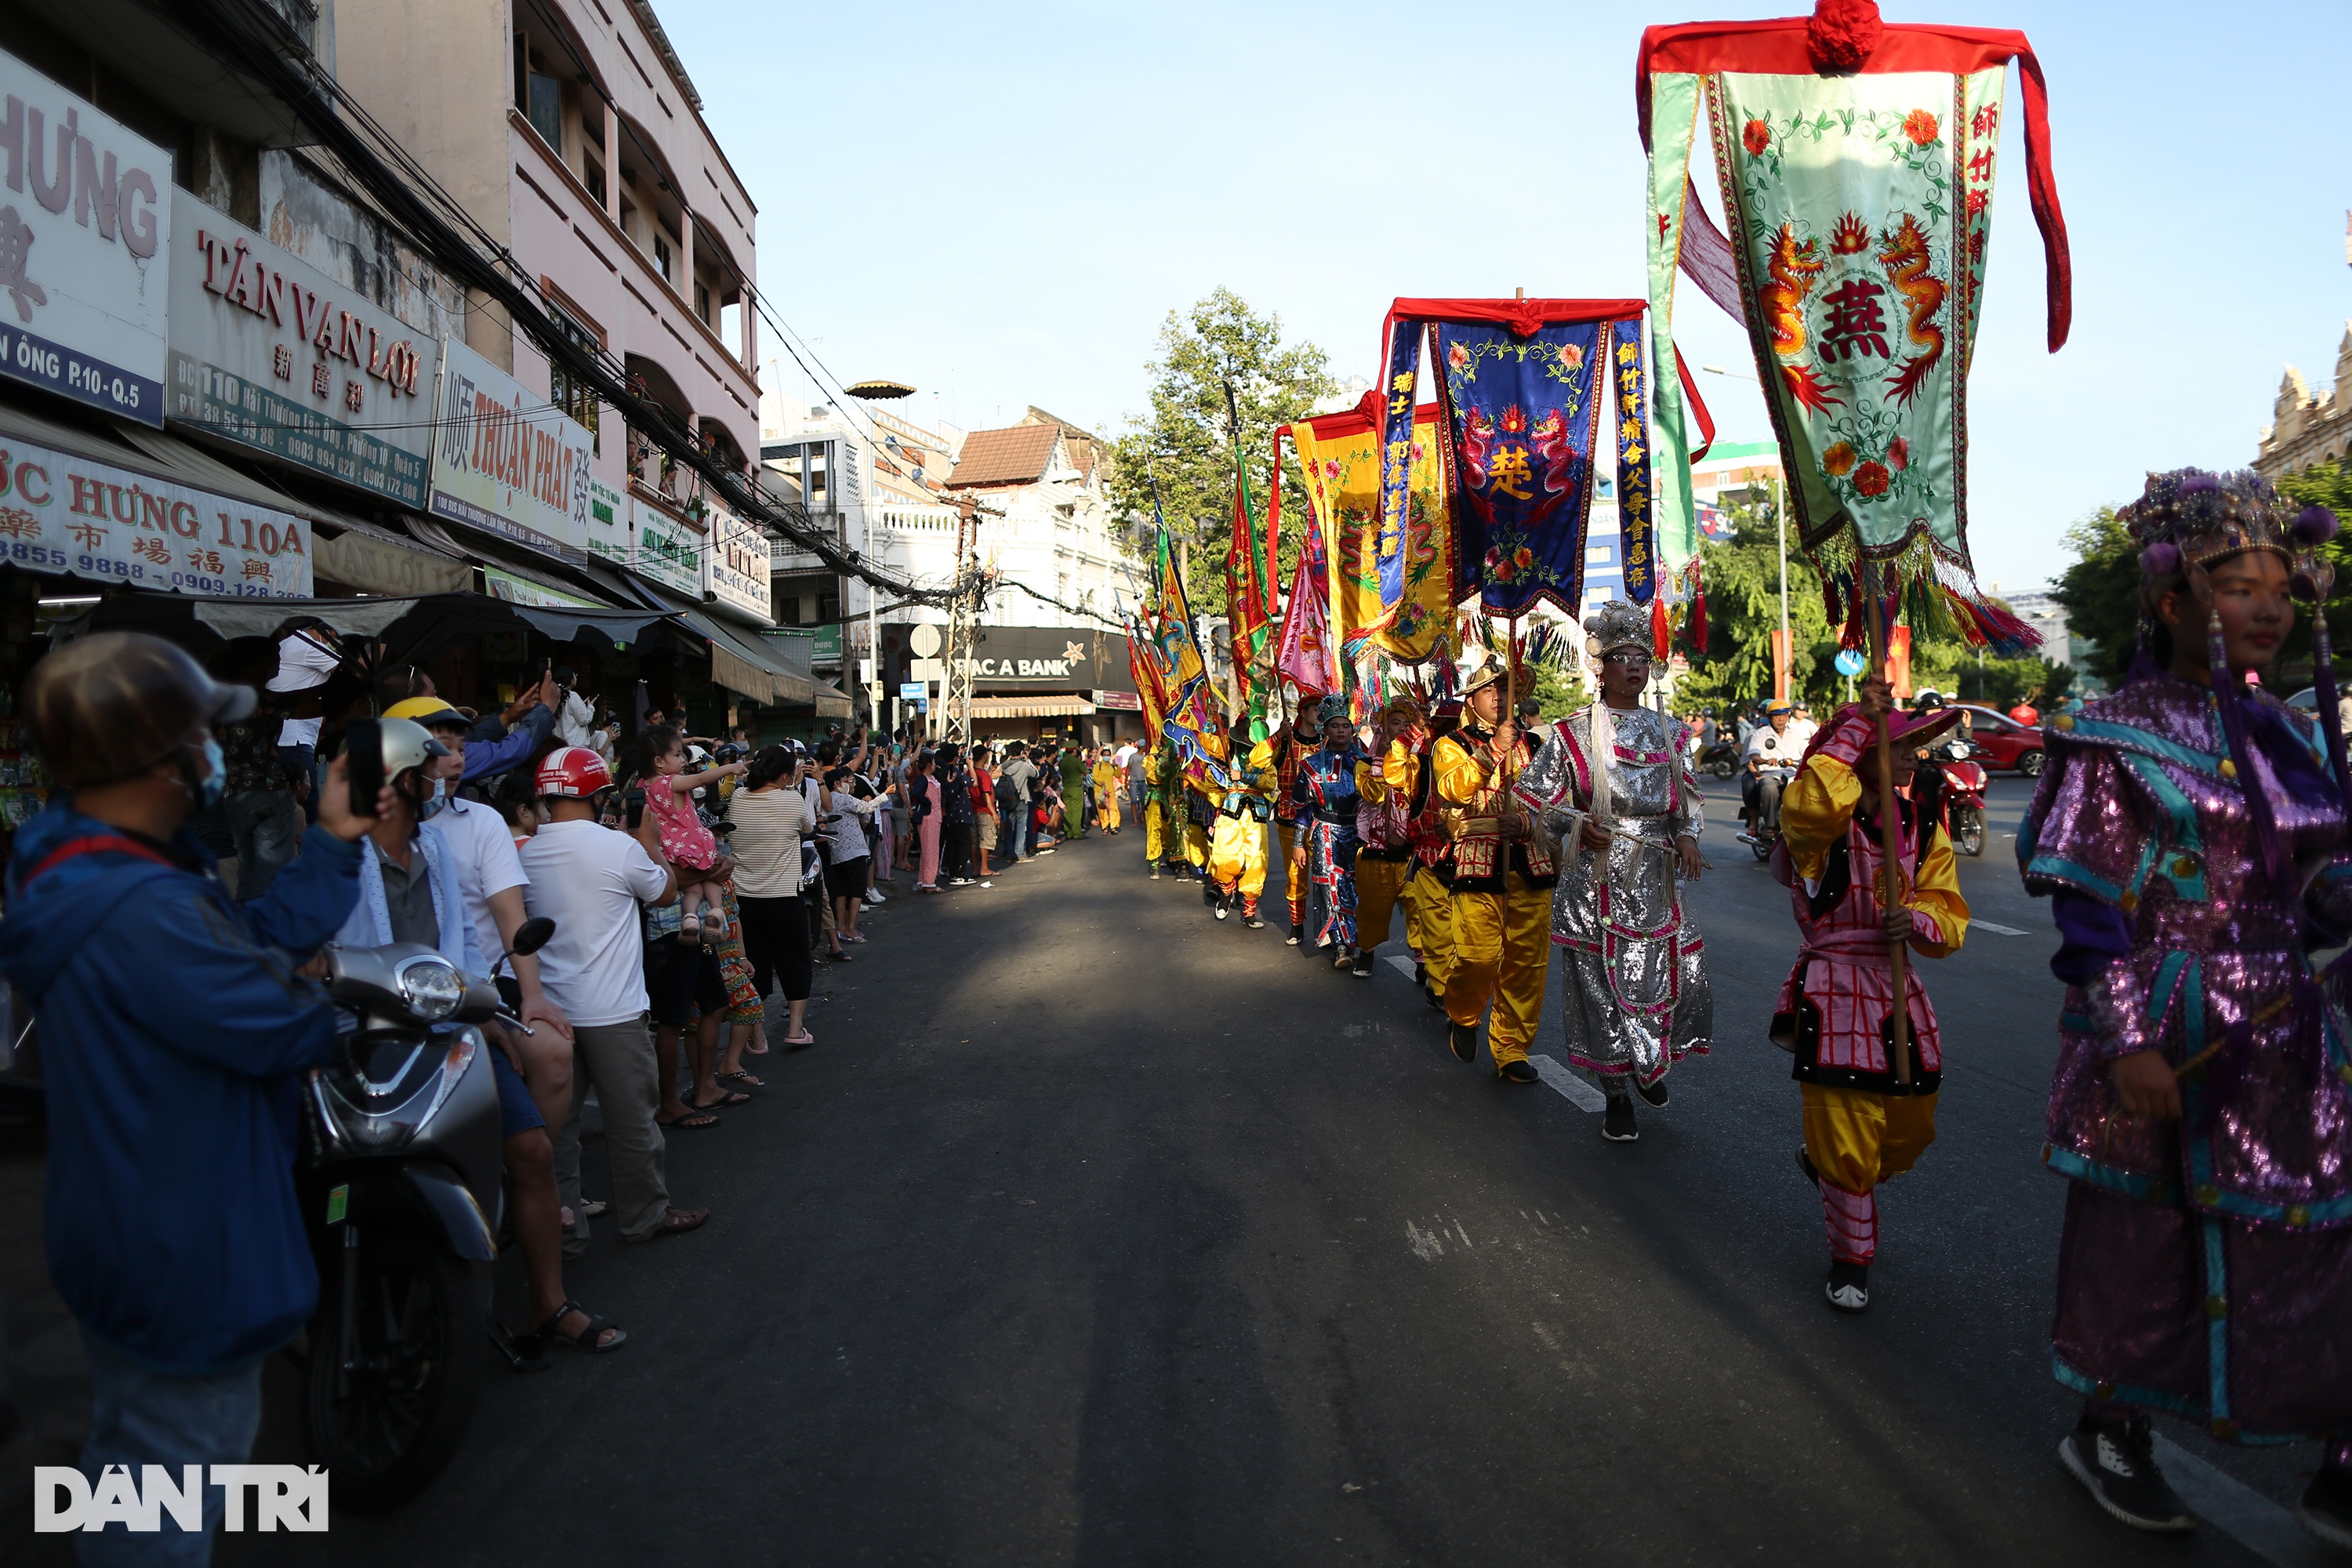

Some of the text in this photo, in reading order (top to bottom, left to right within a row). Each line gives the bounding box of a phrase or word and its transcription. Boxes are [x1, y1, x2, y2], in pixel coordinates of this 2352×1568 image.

[198, 230, 421, 398] TÂN VẠN LỢI
[1817, 278, 1891, 365] 燕
[16, 335, 60, 379] ÔNG
[68, 360, 101, 394] P.10
[111, 378, 140, 408] Q.5
[274, 343, 365, 413] 新萬利
[201, 366, 239, 407] 110
[243, 387, 260, 414] Hải
[303, 413, 320, 439] Lãn
[347, 432, 378, 465] Phường
[379, 446, 388, 467] 10
[394, 452, 416, 479] Quận
[414, 461, 420, 480] 5
[205, 402, 220, 425] 38
[223, 410, 238, 433] 55
[242, 418, 257, 441] 99
[260, 426, 274, 447] 86
[288, 437, 313, 462] 0903
[317, 448, 336, 470] 994
[338, 456, 355, 477] 628
[364, 466, 385, 489] 0903
[387, 477, 401, 495] 172
[402, 487, 418, 502] 808
[472, 390, 572, 514] THUẬN PHÁT
[1488, 445, 1534, 500] 楚
[1615, 342, 1650, 588] 師竹軒精舍父母會惠存
[67, 473, 200, 541] HƯNG
[217, 513, 304, 557] 110A
[437, 495, 448, 510] 108
[593, 497, 614, 526] NAM
[78, 555, 143, 579] 9888
[814, 641, 833, 650] DƯỢC
[999, 659, 1014, 676] A
[1018, 659, 1070, 676] BANK
